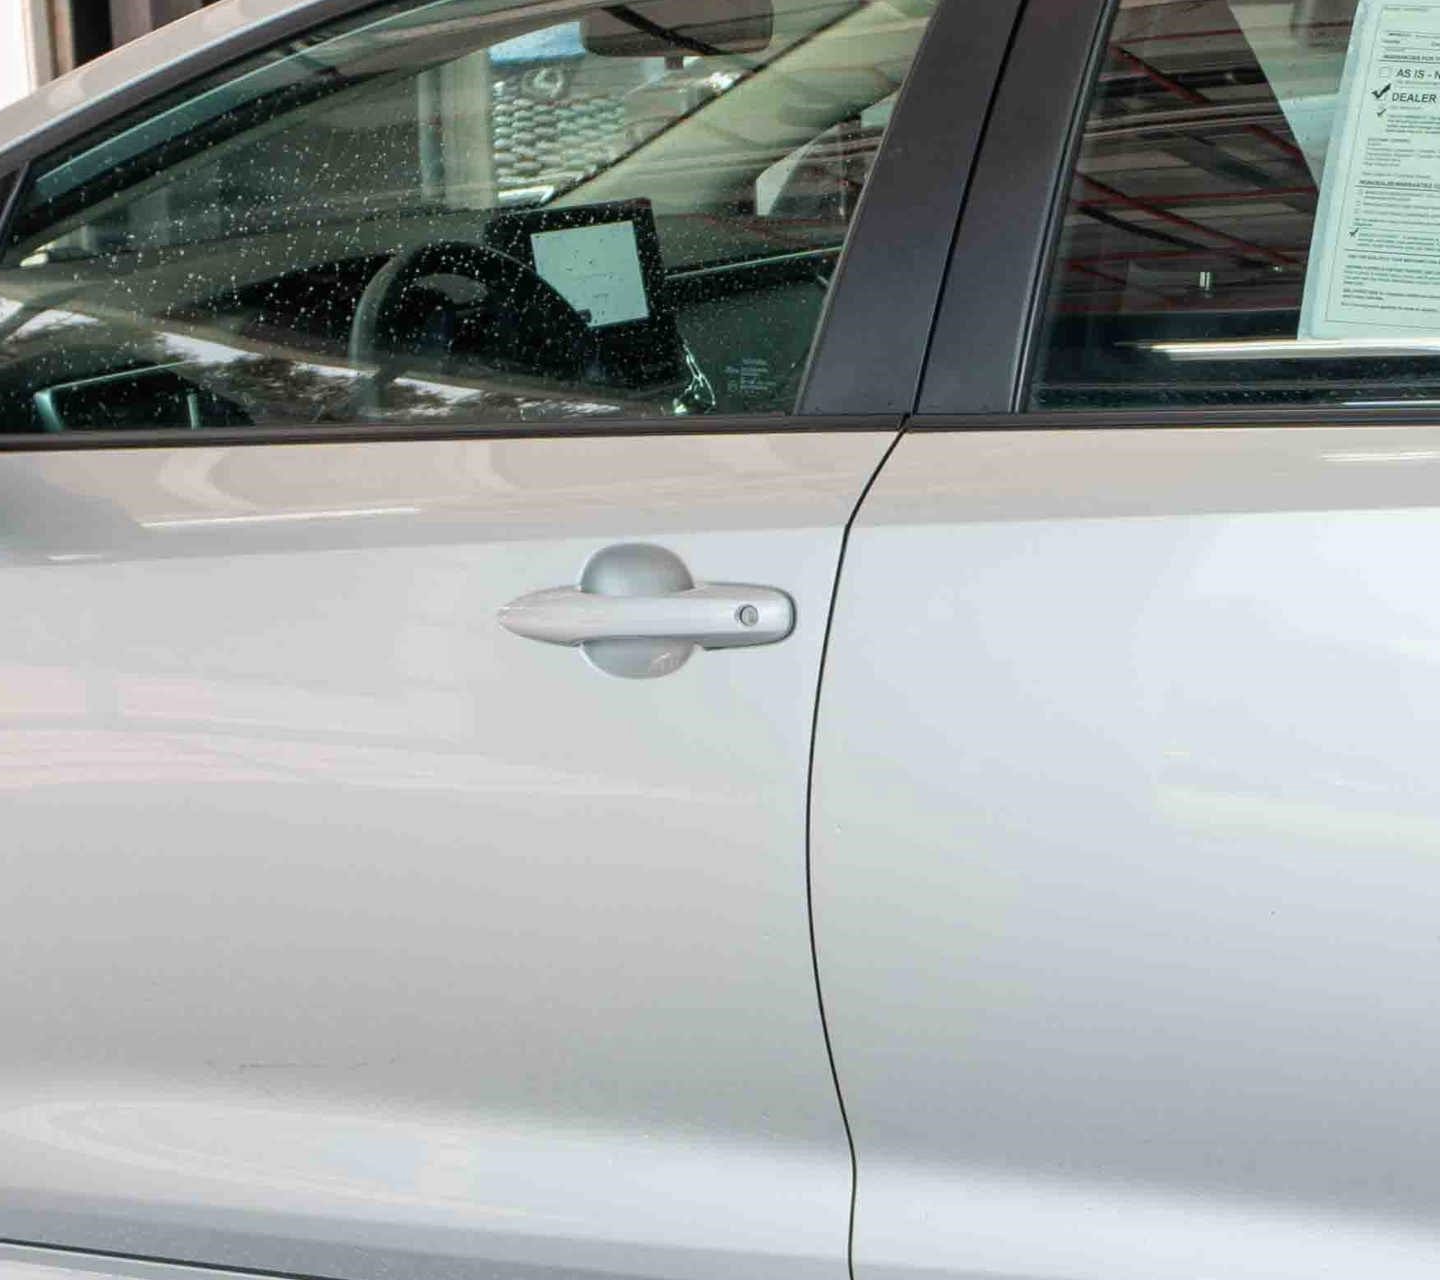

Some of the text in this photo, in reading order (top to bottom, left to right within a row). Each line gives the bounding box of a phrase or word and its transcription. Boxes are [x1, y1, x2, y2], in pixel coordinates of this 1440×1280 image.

[1396, 69, 1412, 79] AS
[1414, 70, 1425, 79] IS
[1391, 92, 1436, 104] DEALER
